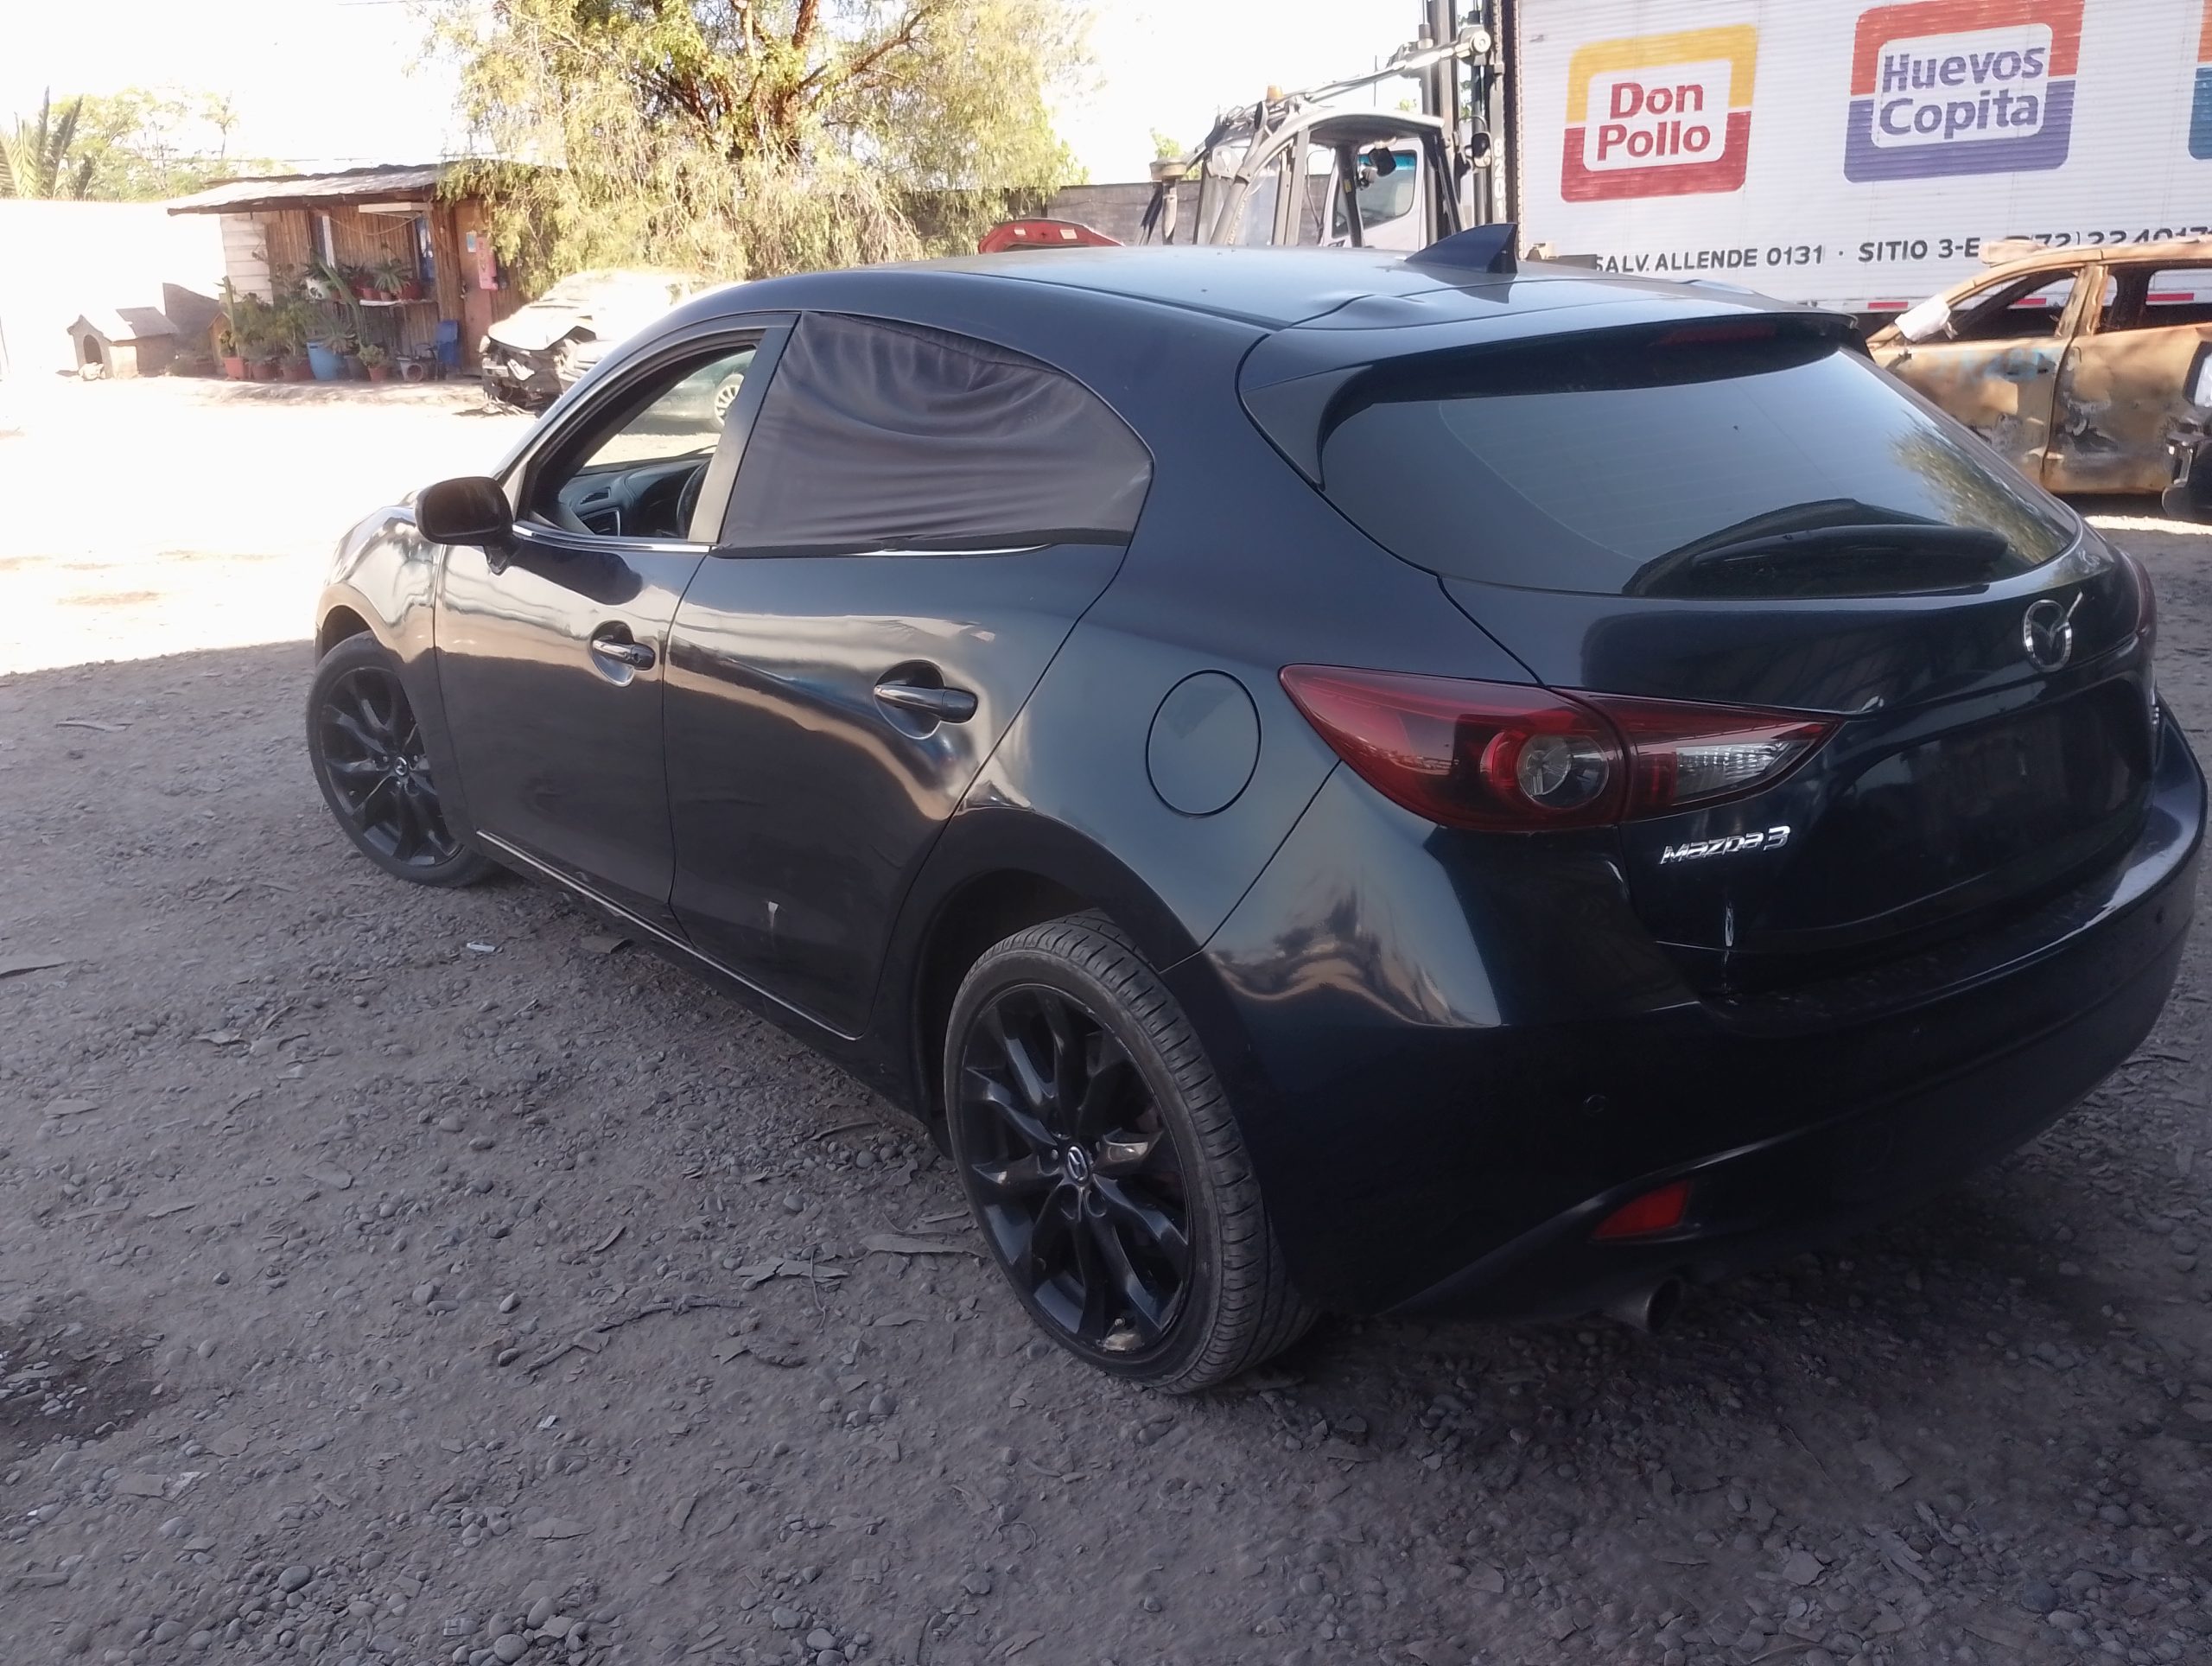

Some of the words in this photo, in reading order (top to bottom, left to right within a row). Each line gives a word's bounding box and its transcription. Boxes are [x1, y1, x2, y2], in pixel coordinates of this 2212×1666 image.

[1882, 47, 2046, 93] Huevos
[1610, 82, 1704, 119] Don
[1879, 88, 2039, 139] Copita
[1597, 120, 1711, 162] Pollo
[1493, 138, 1504, 219] 8201
[1655, 248, 1758, 271] ALLENDE
[1766, 245, 1822, 266] 0131
[1858, 239, 1928, 263] SITIO
[1938, 237, 1981, 258] 3-E
